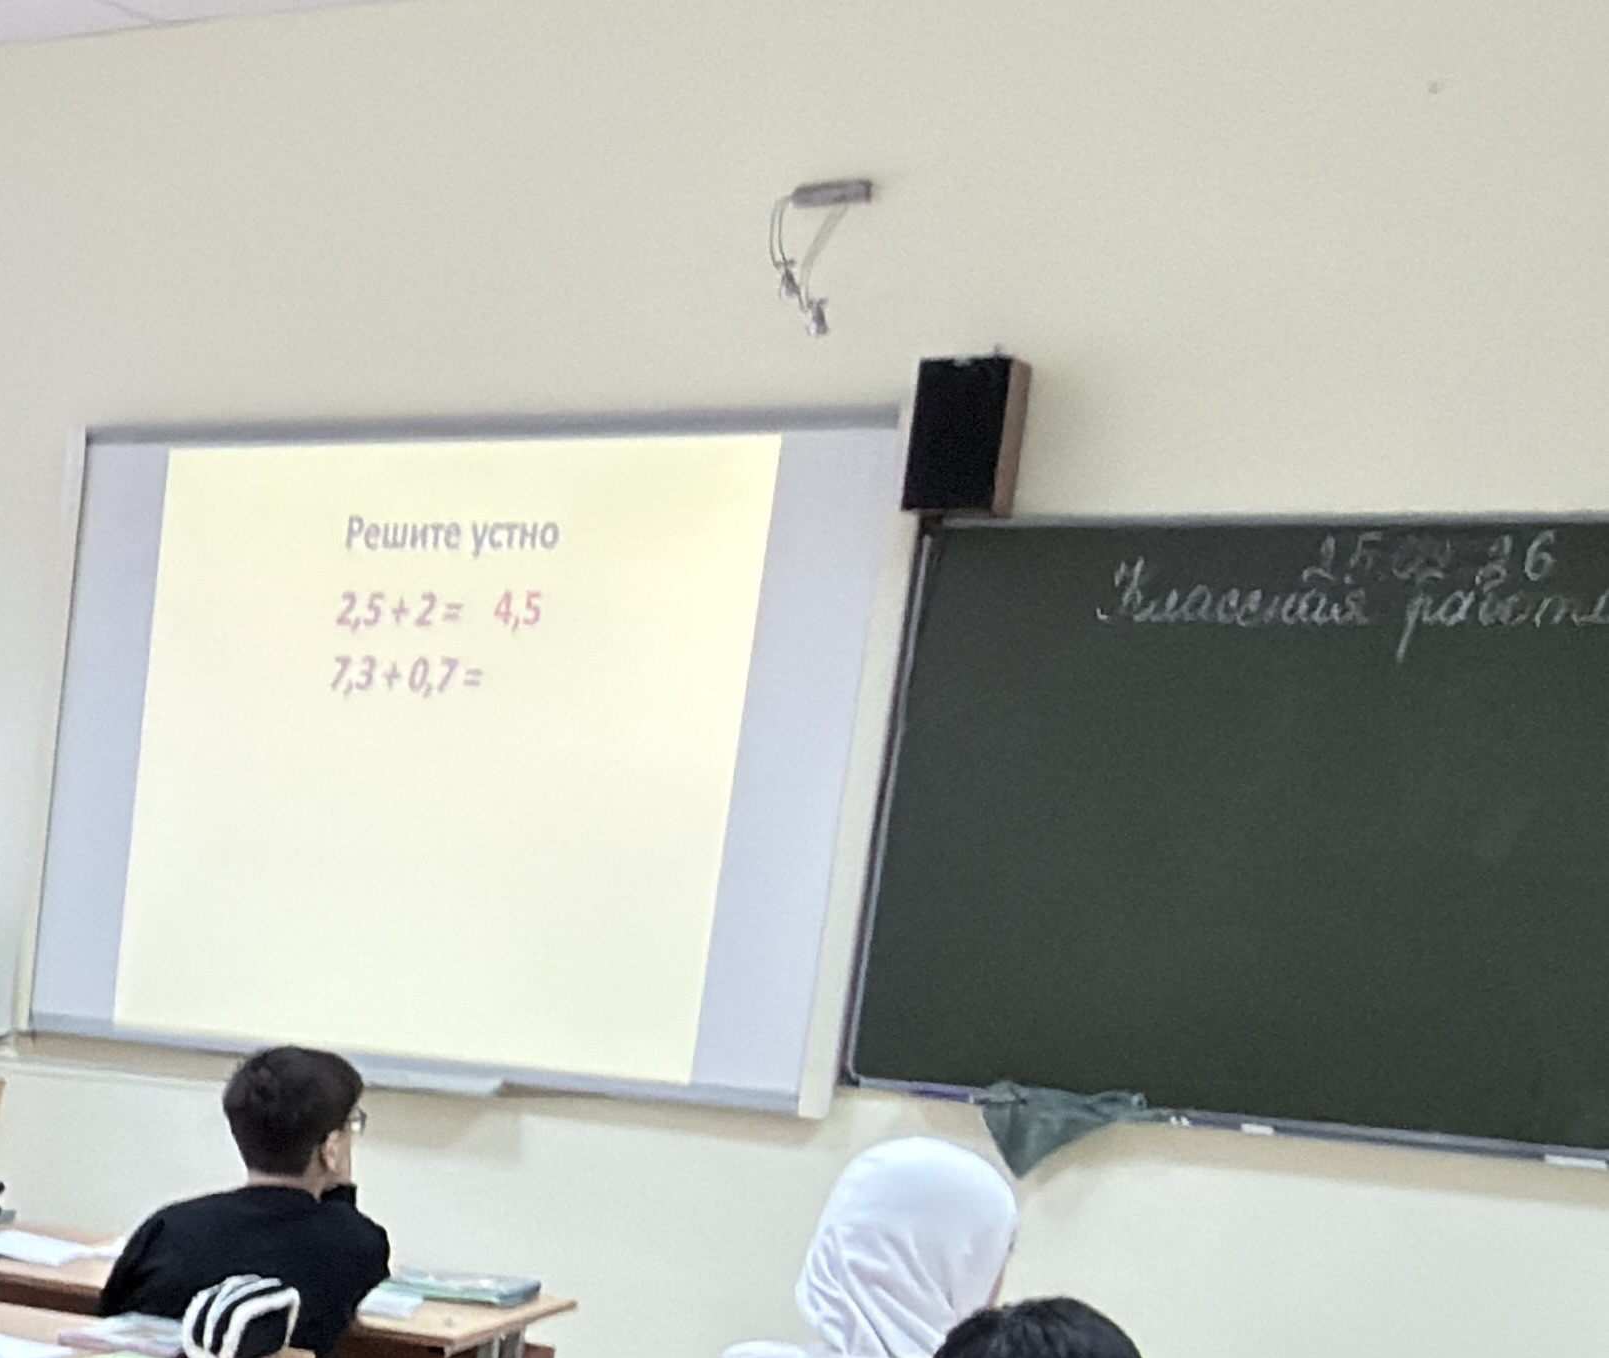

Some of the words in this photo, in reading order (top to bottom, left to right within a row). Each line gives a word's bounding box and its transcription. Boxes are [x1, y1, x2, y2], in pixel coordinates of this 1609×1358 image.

[345, 514, 461, 551] Решите
[471, 520, 560, 559] устно
[493, 589, 542, 633] 4,5
